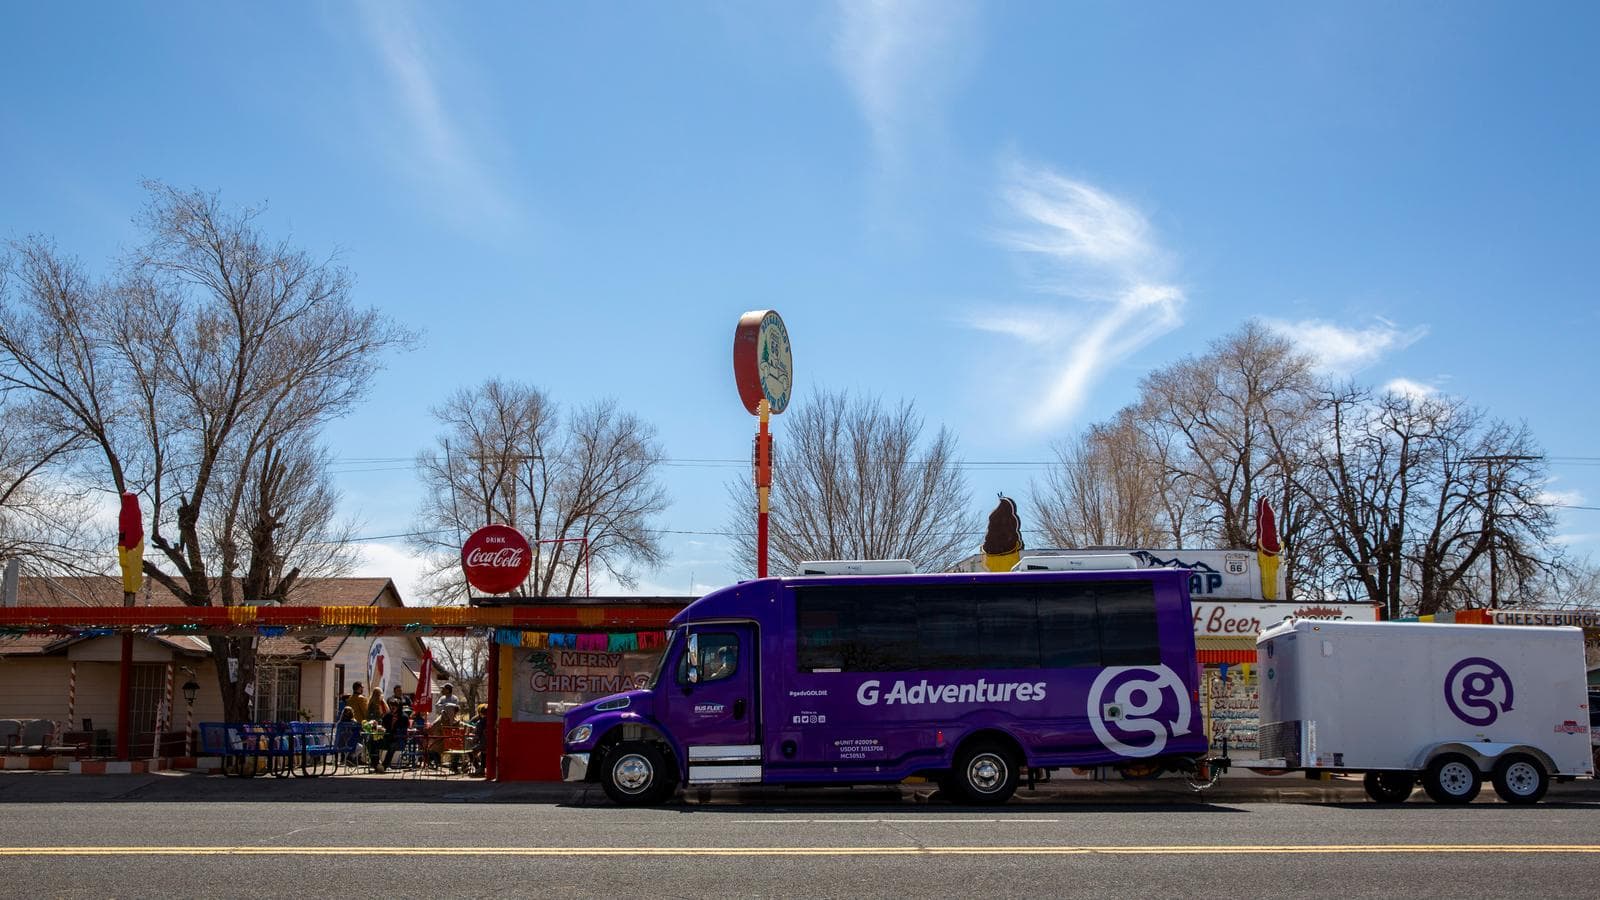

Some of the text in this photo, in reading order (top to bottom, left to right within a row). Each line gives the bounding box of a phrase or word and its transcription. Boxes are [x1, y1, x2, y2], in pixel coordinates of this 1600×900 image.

[466, 547, 523, 568] Coca-Cola
[1230, 564, 1243, 572] 66
[1189, 574, 1223, 594] AP
[1206, 605, 1261, 634] Beer
[561, 651, 622, 668] MERRY
[856, 678, 1047, 706] G Adventures
